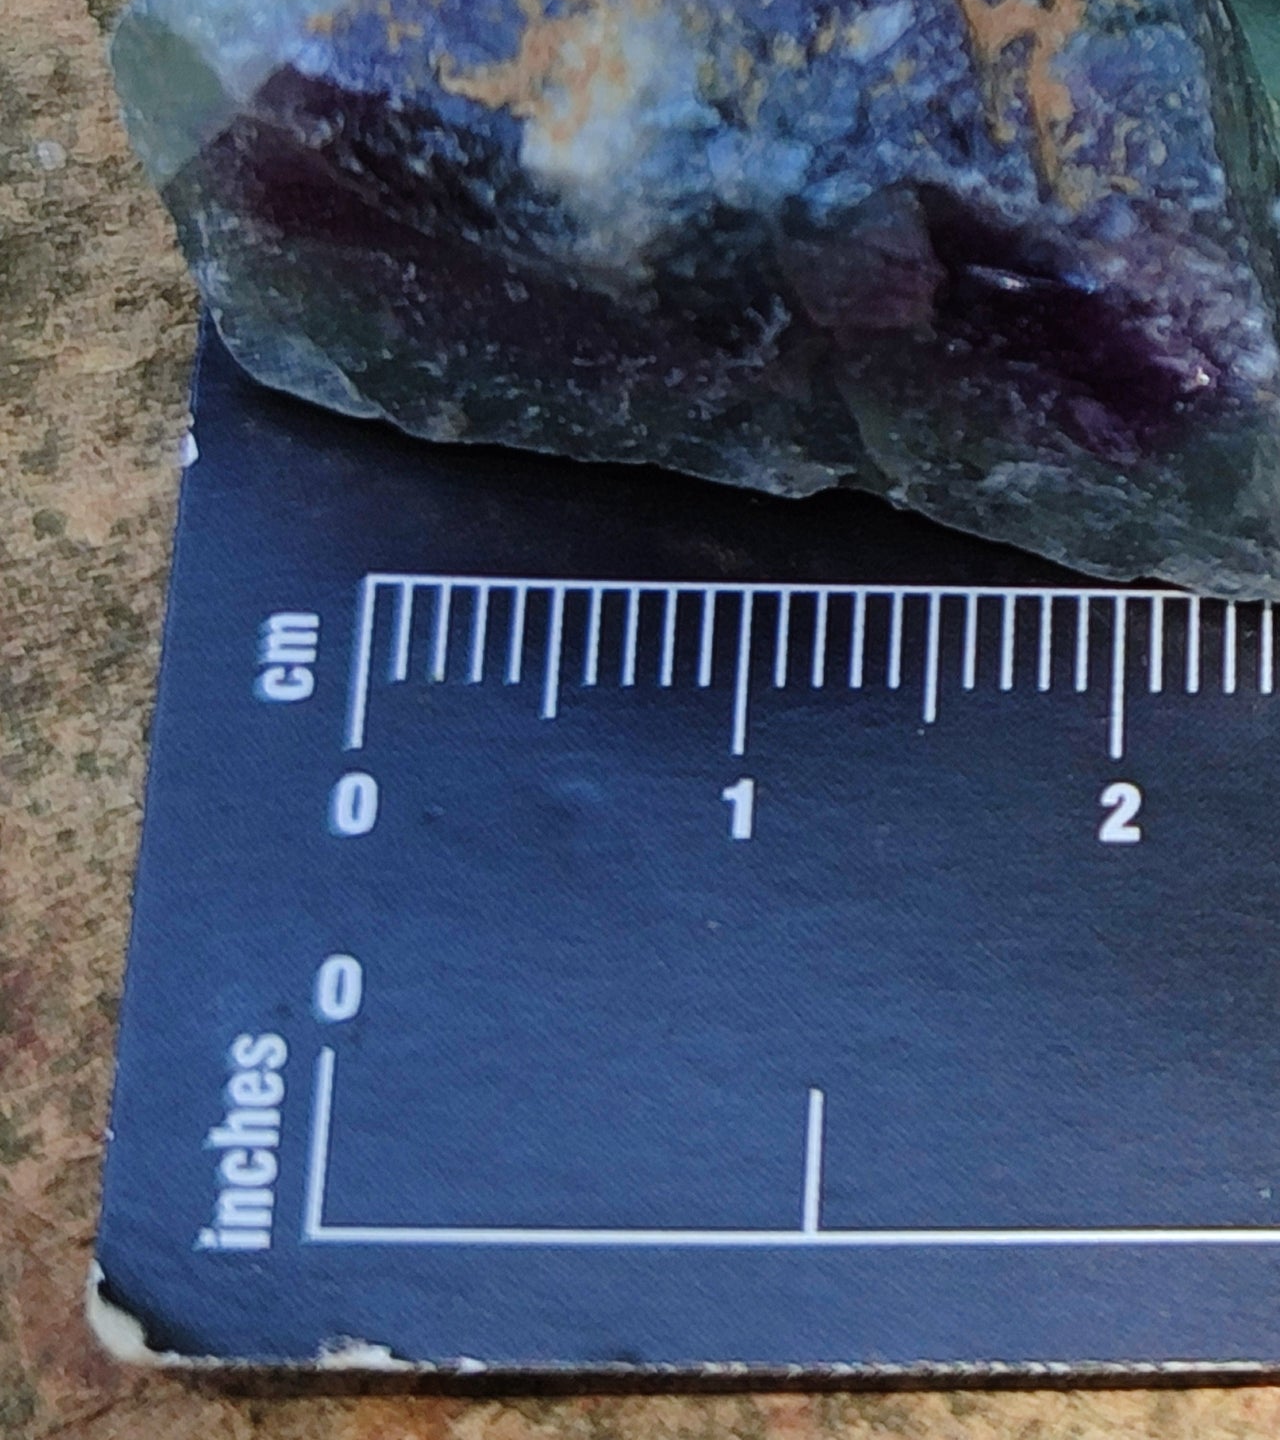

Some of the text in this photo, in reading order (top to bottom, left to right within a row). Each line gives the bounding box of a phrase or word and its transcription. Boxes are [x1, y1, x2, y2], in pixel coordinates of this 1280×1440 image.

[258, 610, 321, 702] cm
[332, 771, 379, 836] 0
[721, 777, 756, 841] 1
[1098, 782, 1143, 844] 2
[315, 953, 364, 1022] 0
[197, 1032, 289, 1251] inches
